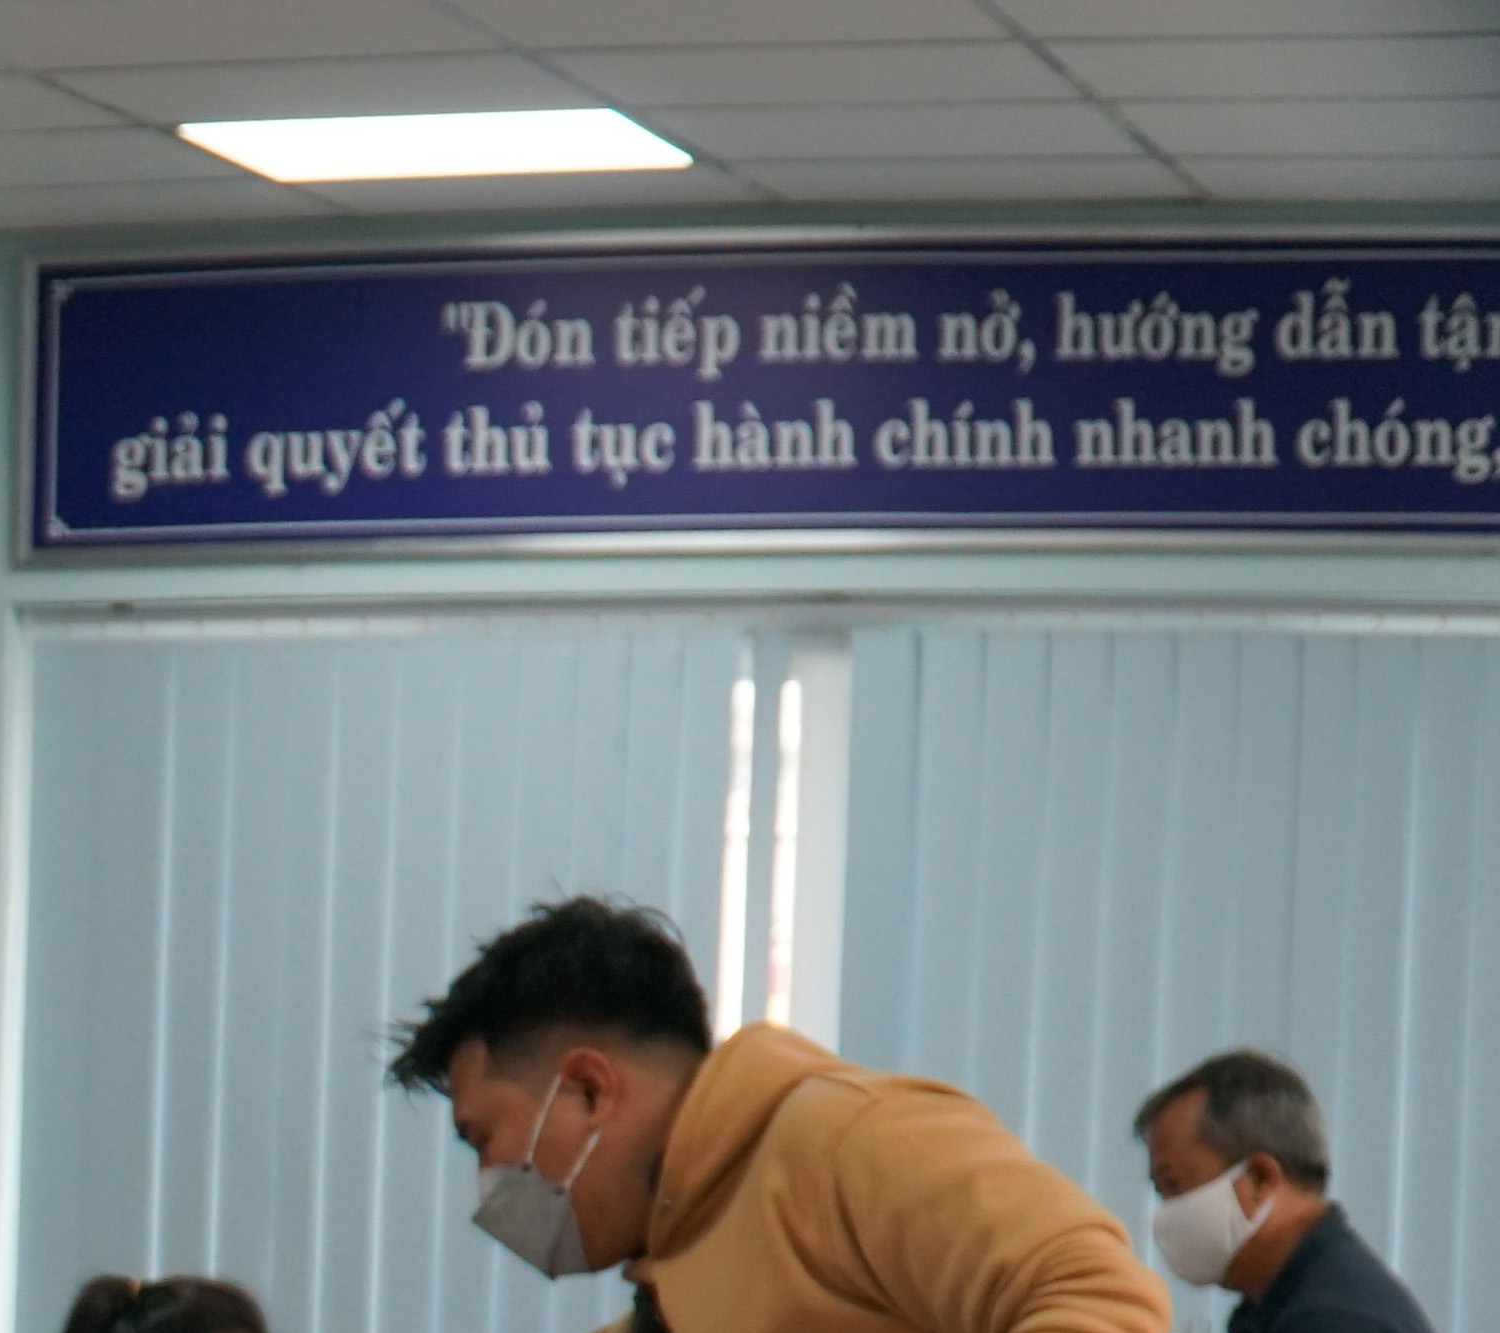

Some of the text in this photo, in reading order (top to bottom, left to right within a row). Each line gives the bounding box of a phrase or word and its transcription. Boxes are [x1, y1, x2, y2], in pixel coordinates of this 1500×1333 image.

[441, 298, 594, 371] "Đón
[613, 284, 740, 382] tiếp
[760, 281, 918, 363] niềm
[1055, 290, 1259, 377] hướng
[1275, 277, 1399, 362] dẫn
[111, 409, 232, 499] giải
[246, 397, 426, 497] quyết
[442, 400, 551, 477] thủ
[572, 407, 676, 490] tục
[692, 398, 857, 471] hành
[872, 397, 1057, 470] chính
[1073, 397, 1280, 469] nhanh
